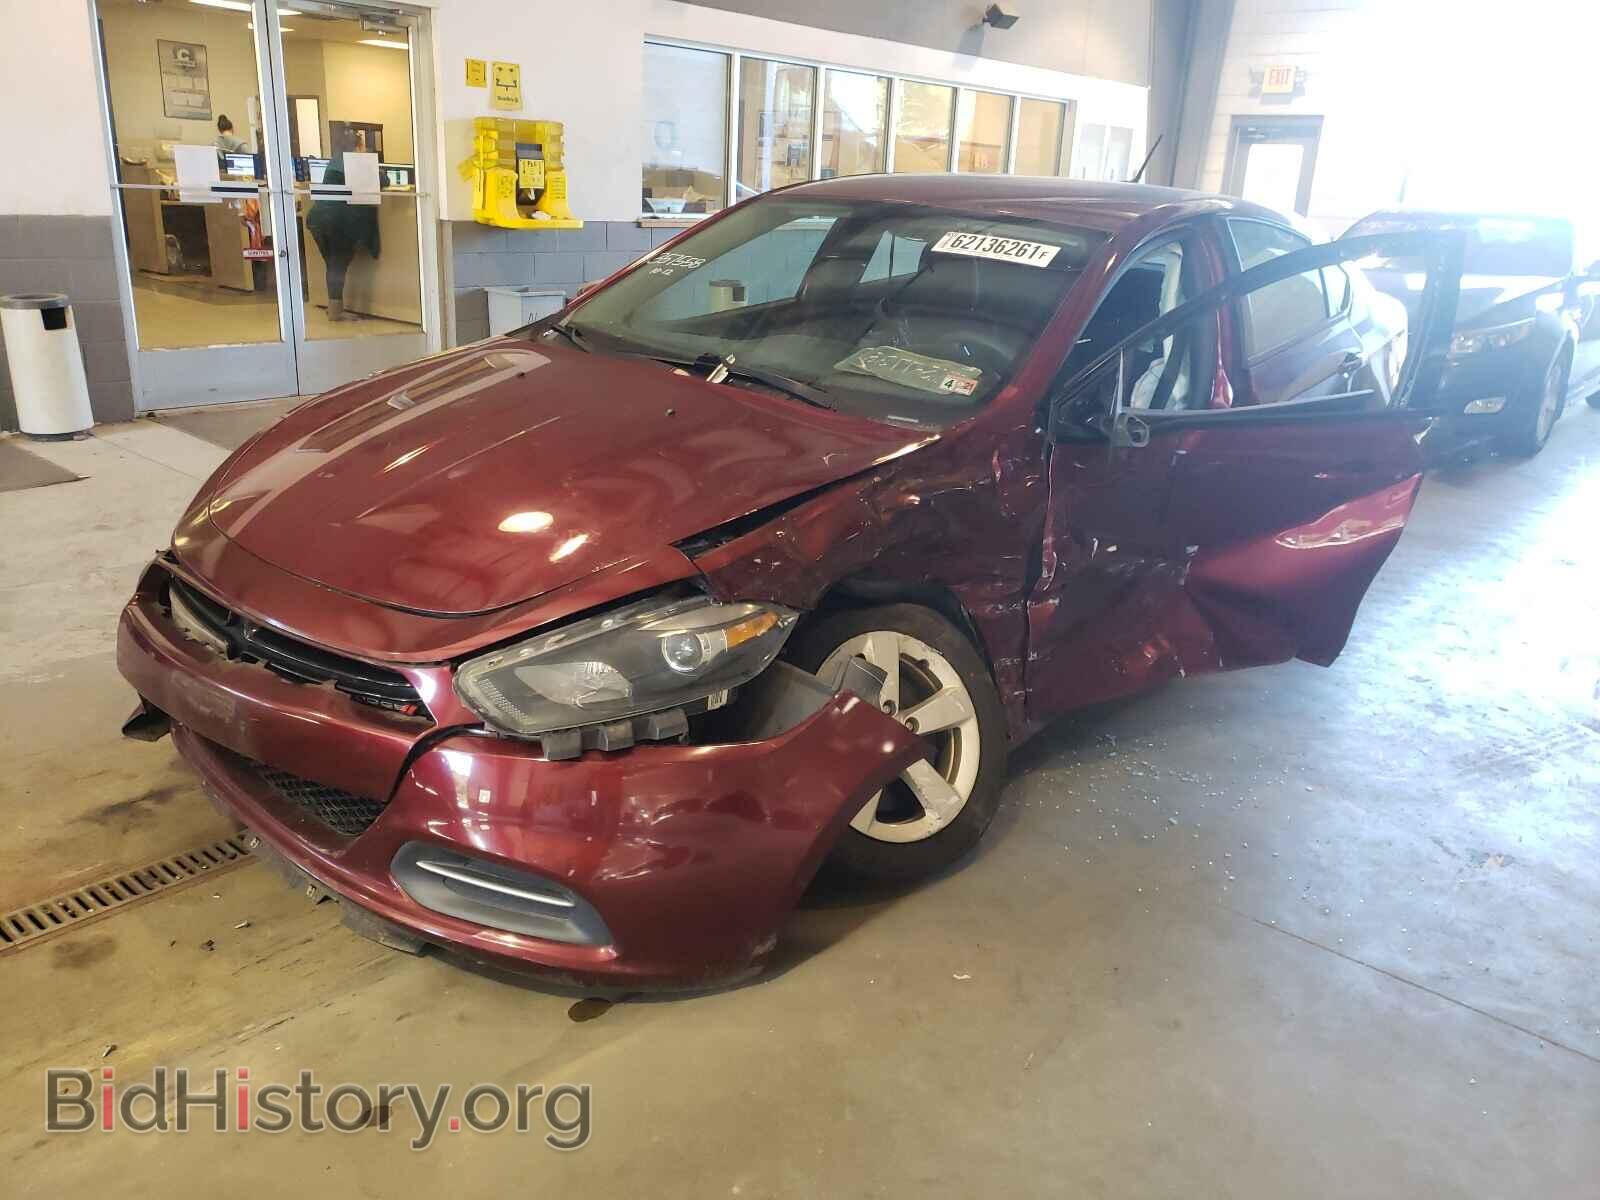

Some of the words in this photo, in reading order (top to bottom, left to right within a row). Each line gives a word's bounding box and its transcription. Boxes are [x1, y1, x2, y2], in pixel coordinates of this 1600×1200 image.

[1269, 68, 1292, 86] EXIT
[949, 234, 1041, 260] 62136261
[943, 378, 955, 390] 4
